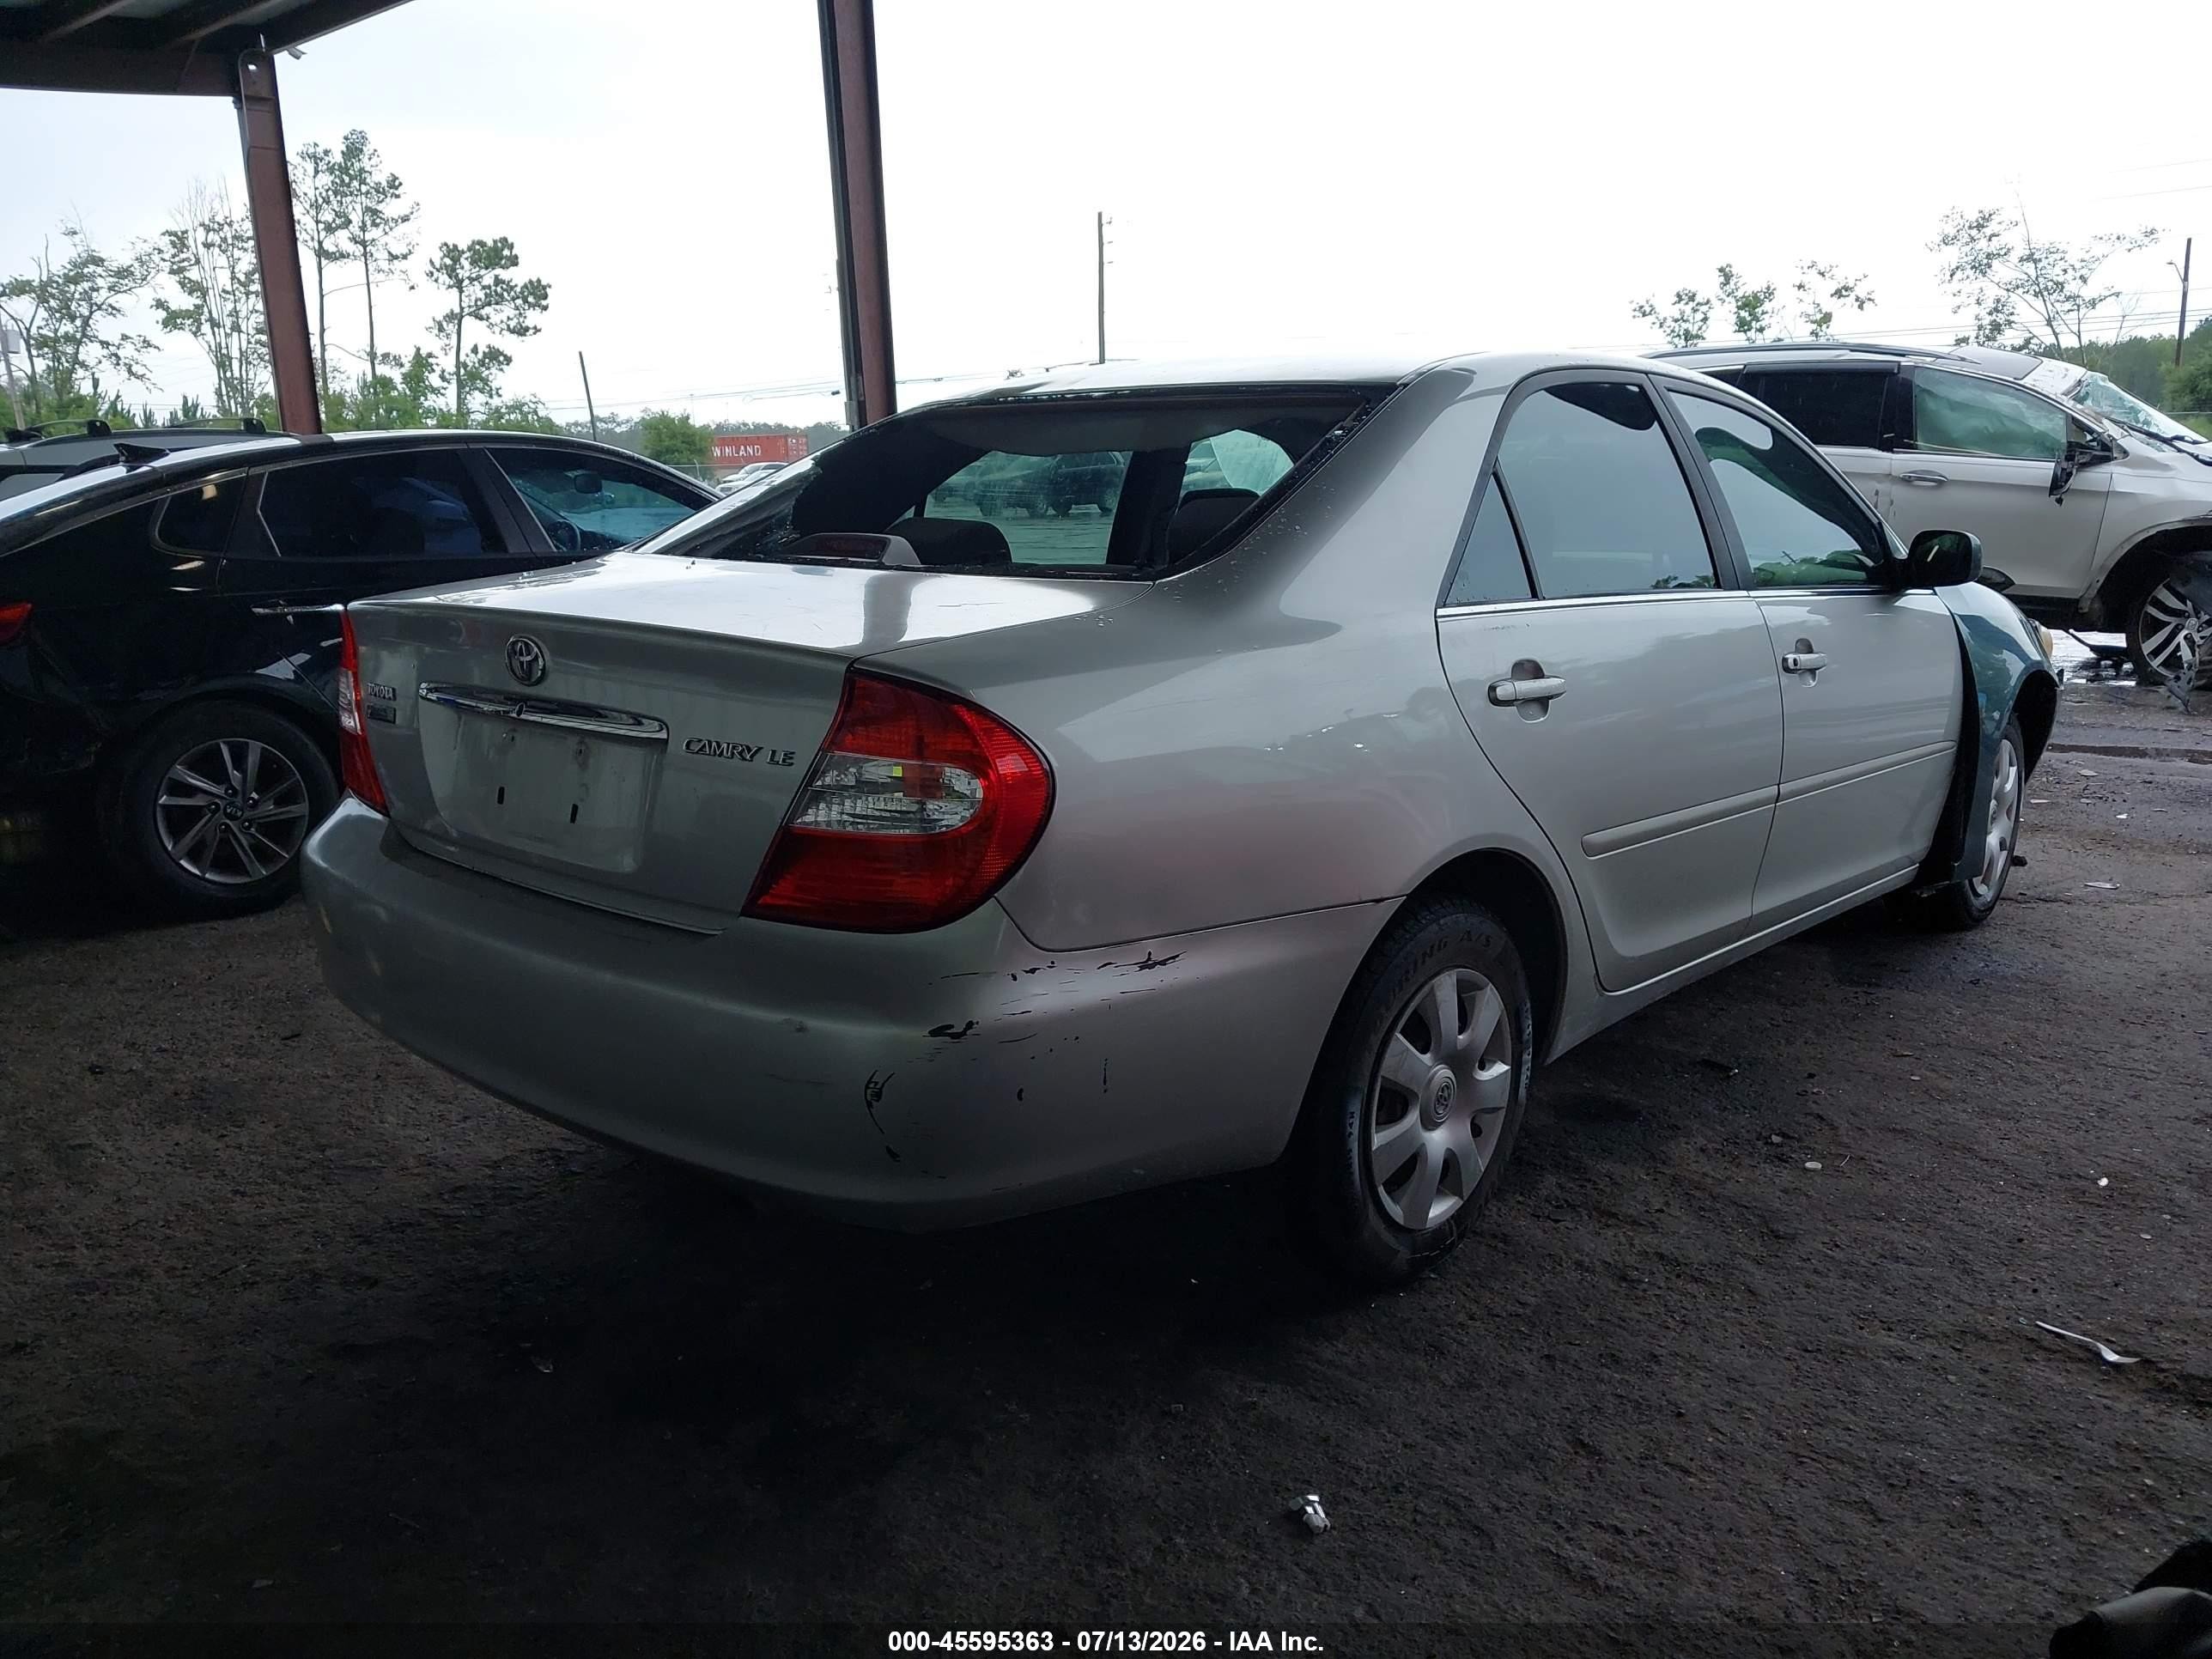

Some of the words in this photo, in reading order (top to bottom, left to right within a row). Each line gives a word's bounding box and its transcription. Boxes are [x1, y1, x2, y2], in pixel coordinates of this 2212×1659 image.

[711, 445, 763, 458] WINLAND
[683, 738, 763, 763] CAMRY
[766, 749, 796, 767] LE
